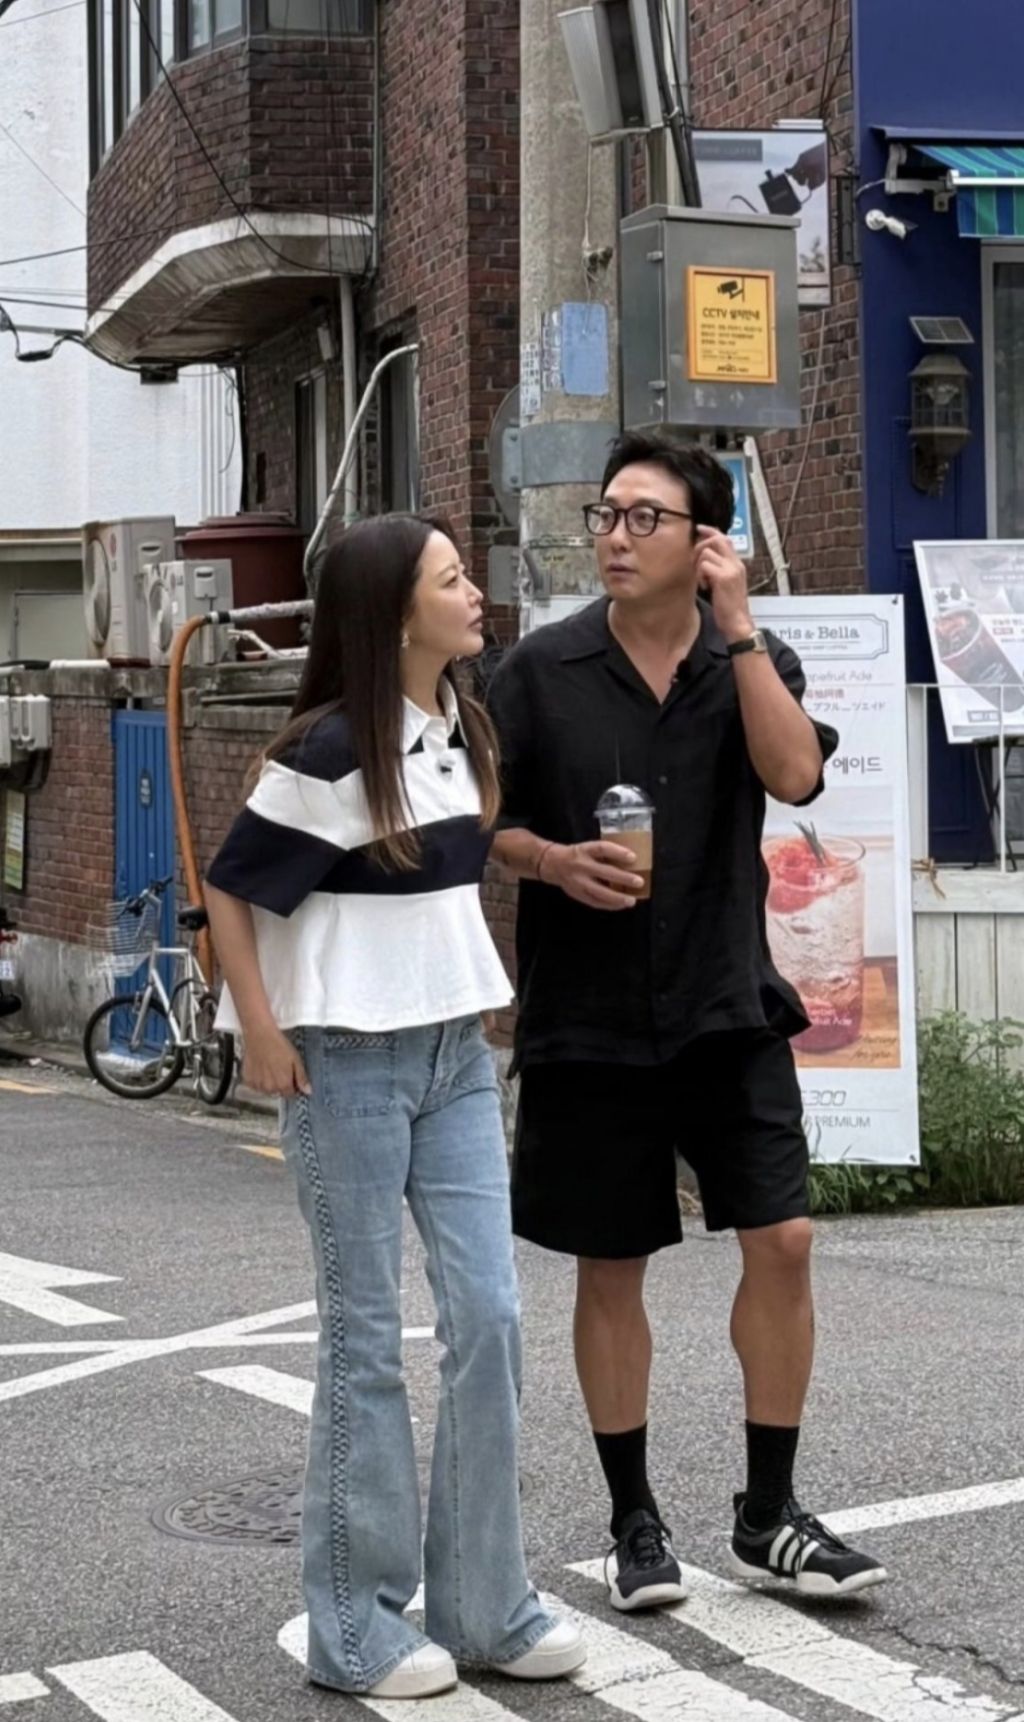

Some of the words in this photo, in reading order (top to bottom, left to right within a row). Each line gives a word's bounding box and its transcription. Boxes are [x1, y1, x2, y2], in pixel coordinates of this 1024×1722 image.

[702, 307, 727, 318] CCTV
[804, 630, 815, 639] &
[818, 626, 860, 639] Bella
[832, 756, 883, 774] 에이드
[815, 1115, 871, 1128] PREMIUM
